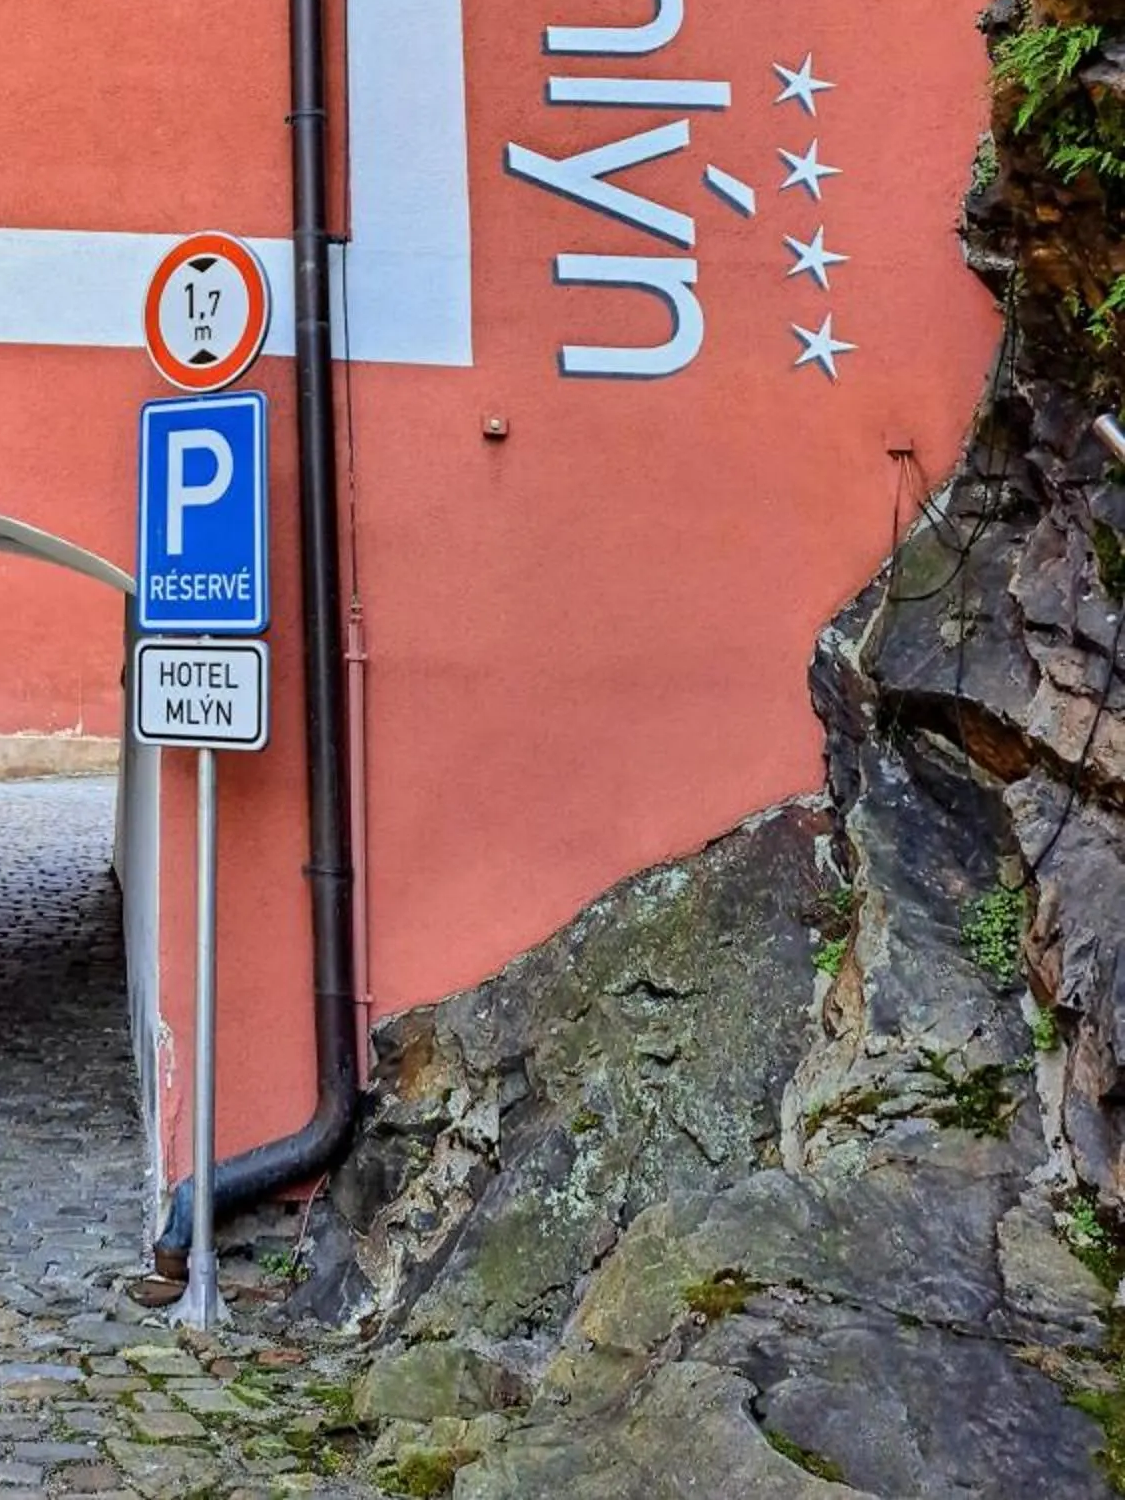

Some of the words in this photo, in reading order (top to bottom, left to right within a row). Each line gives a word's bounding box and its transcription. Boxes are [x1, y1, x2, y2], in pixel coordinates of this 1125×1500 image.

[194, 325, 212, 341] m
[167, 429, 234, 556] P
[150, 567, 251, 601] RÉSERVÉ
[160, 661, 239, 690] HOTEL
[166, 693, 233, 726] MLÝN
